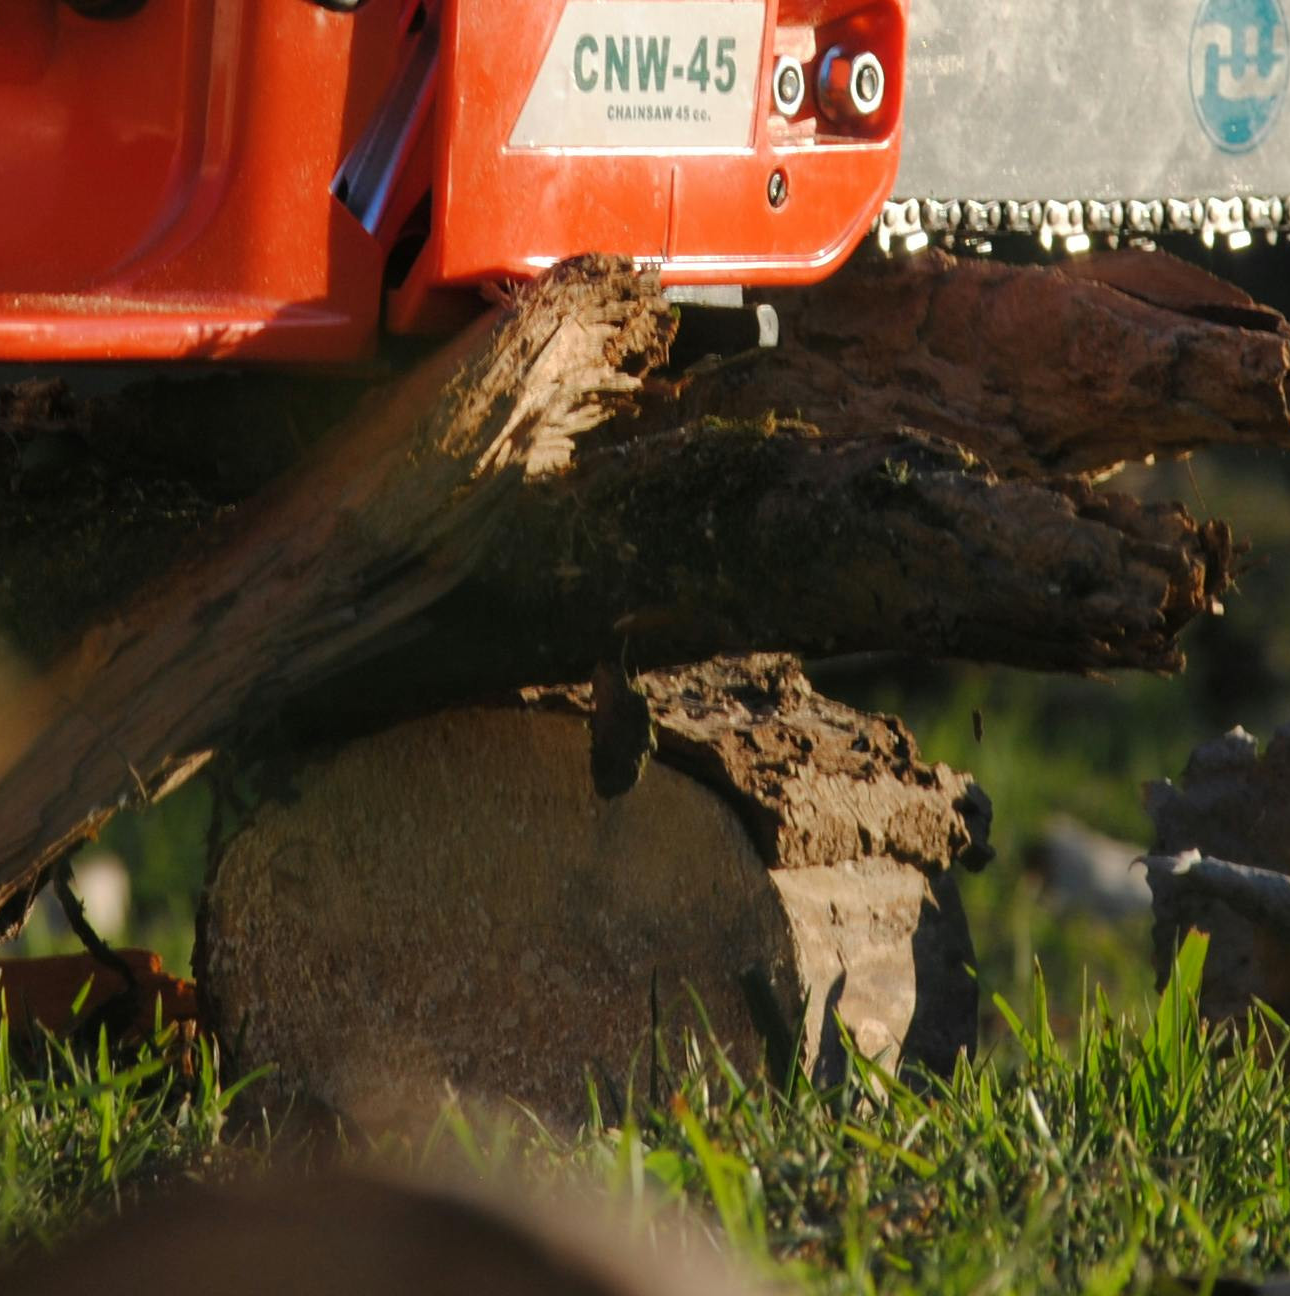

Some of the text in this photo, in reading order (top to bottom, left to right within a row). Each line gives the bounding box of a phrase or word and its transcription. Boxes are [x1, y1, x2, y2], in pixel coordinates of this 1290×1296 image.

[574, 34, 737, 94] CNW-45
[607, 105, 673, 120] CHAINSAW
[675, 106, 690, 120] 45
